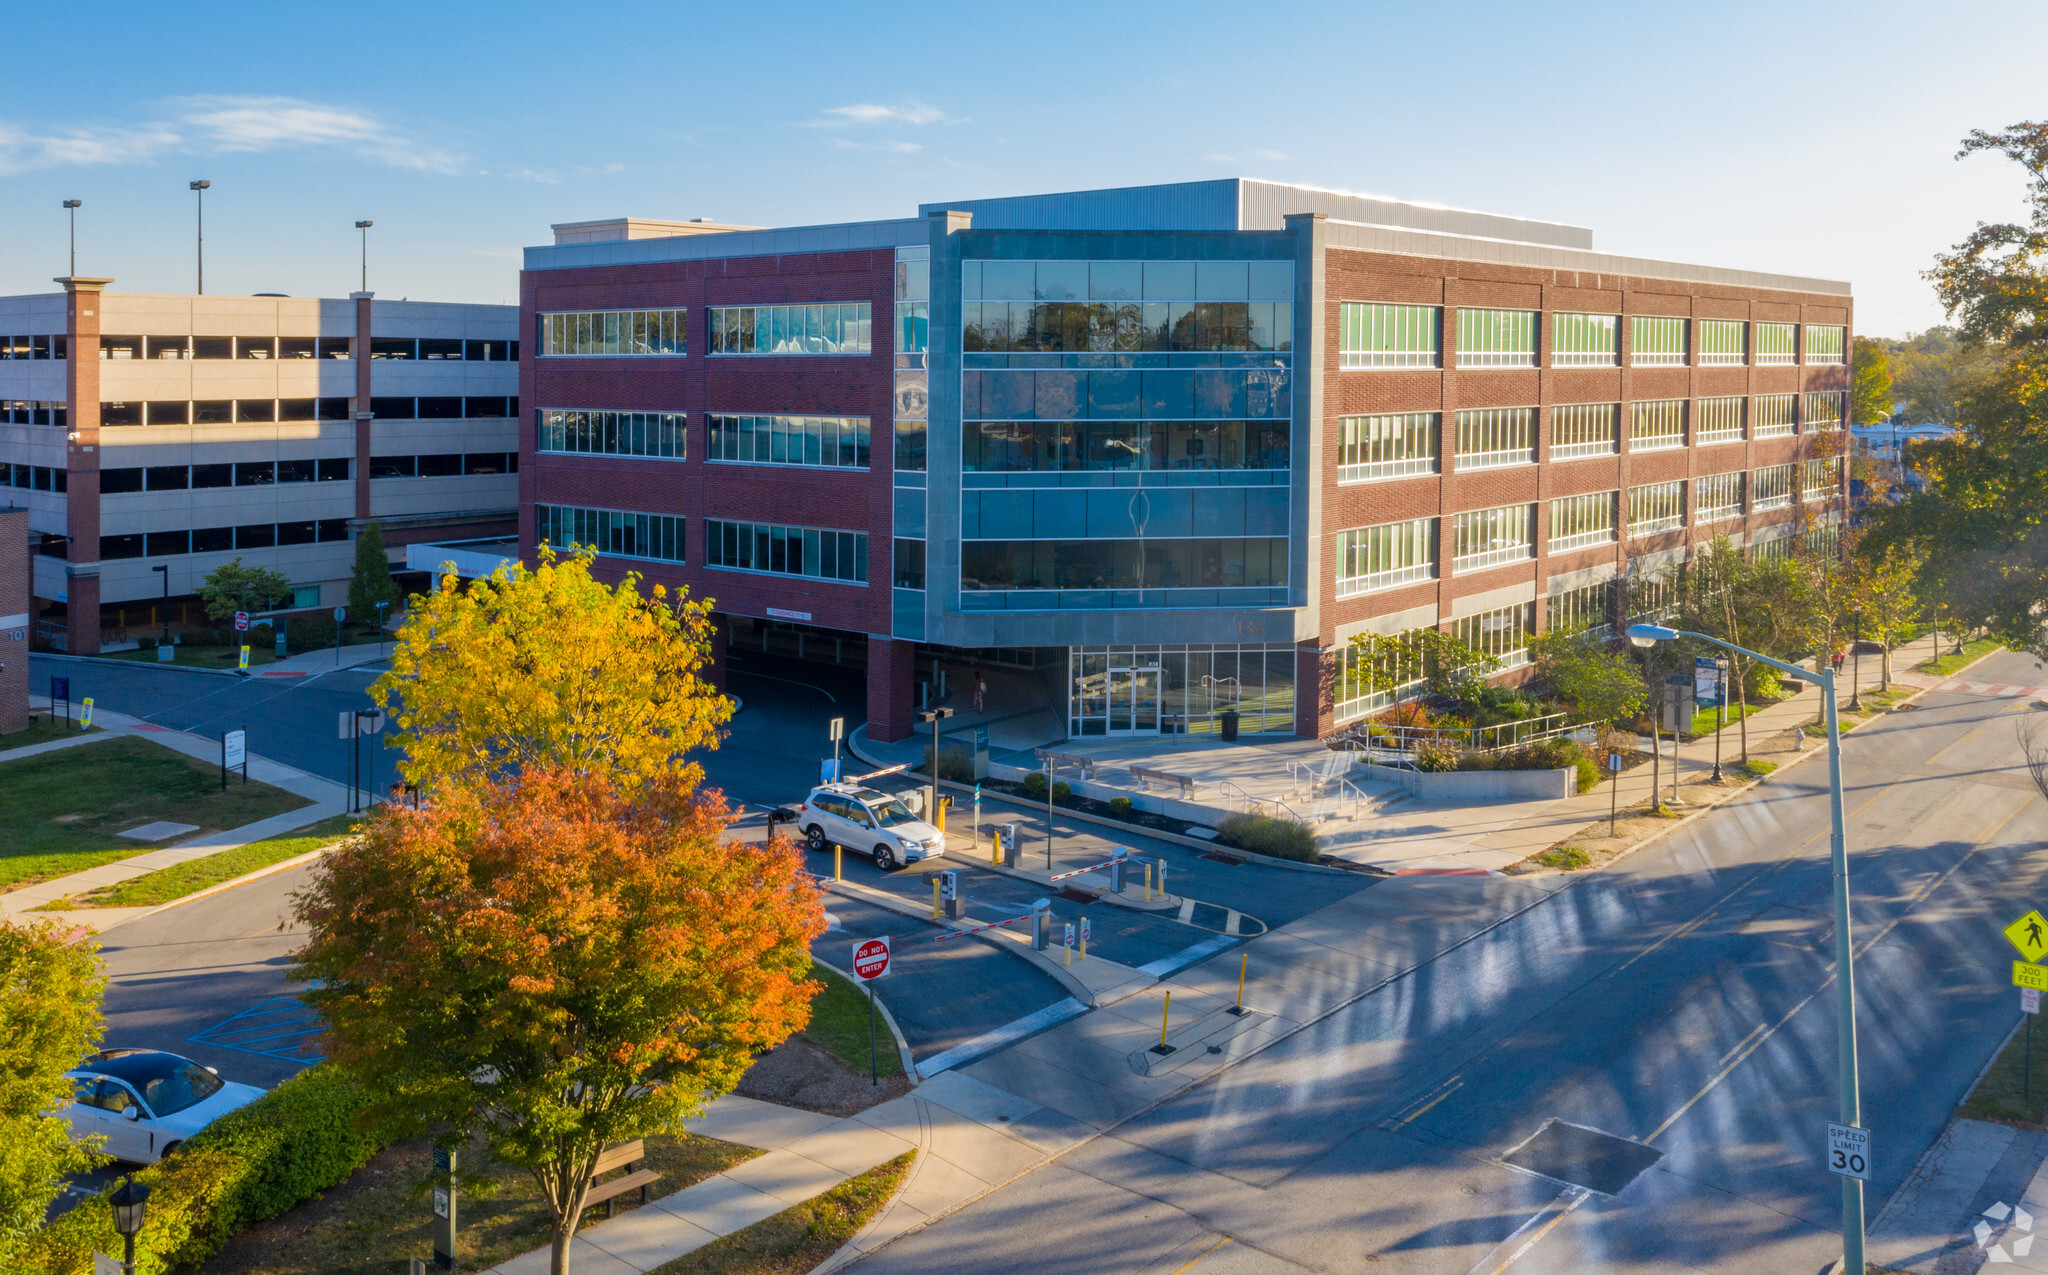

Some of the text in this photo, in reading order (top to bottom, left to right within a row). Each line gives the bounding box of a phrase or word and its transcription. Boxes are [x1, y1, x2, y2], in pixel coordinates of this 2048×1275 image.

[9, 630, 27, 642] 101
[859, 945, 884, 957] DO NOT
[861, 963, 882, 974] ENTER
[2021, 966, 2040, 977] 300
[2018, 975, 2042, 986] FEET
[1830, 1128, 1866, 1143] SPEED
[1834, 1140, 1862, 1152] LIMIT
[1832, 1150, 1865, 1173] 30
